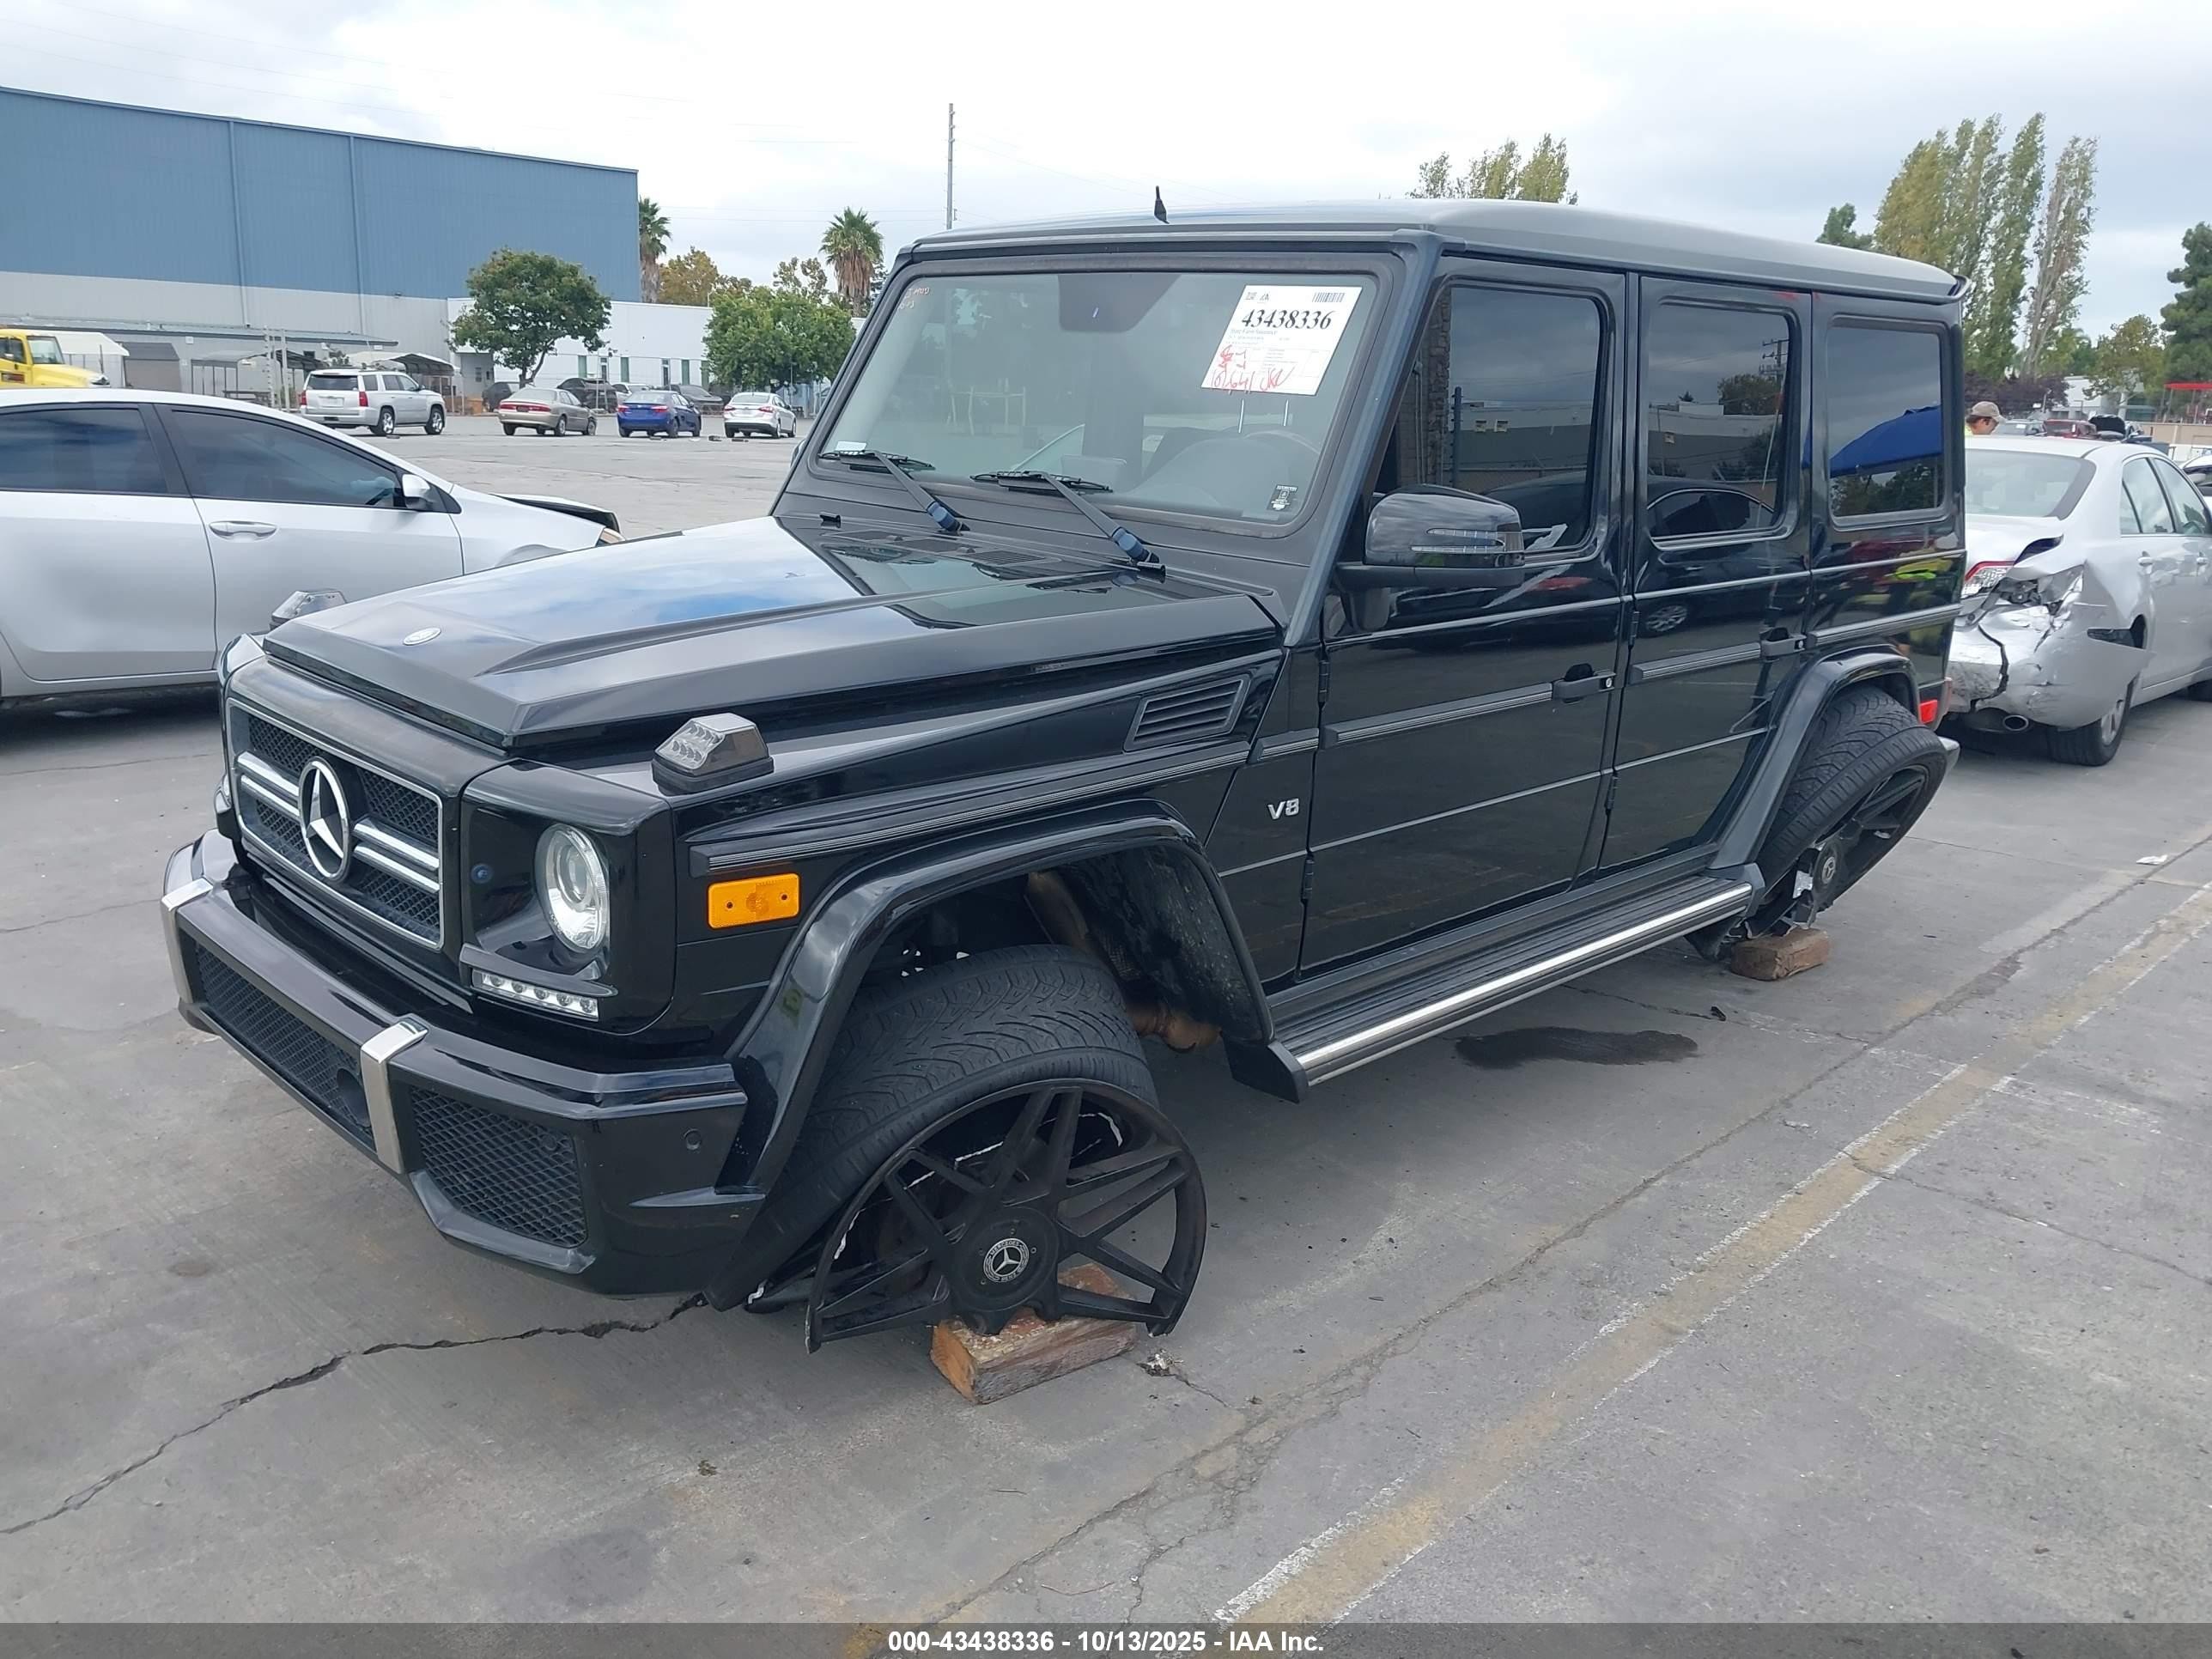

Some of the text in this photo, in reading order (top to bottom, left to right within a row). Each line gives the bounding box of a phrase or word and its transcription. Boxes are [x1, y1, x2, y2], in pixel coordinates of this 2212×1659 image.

[1242, 308, 1336, 330] 43438336
[1267, 798, 1299, 820] V8
[990, 1240, 1019, 1255] MERCEDES
